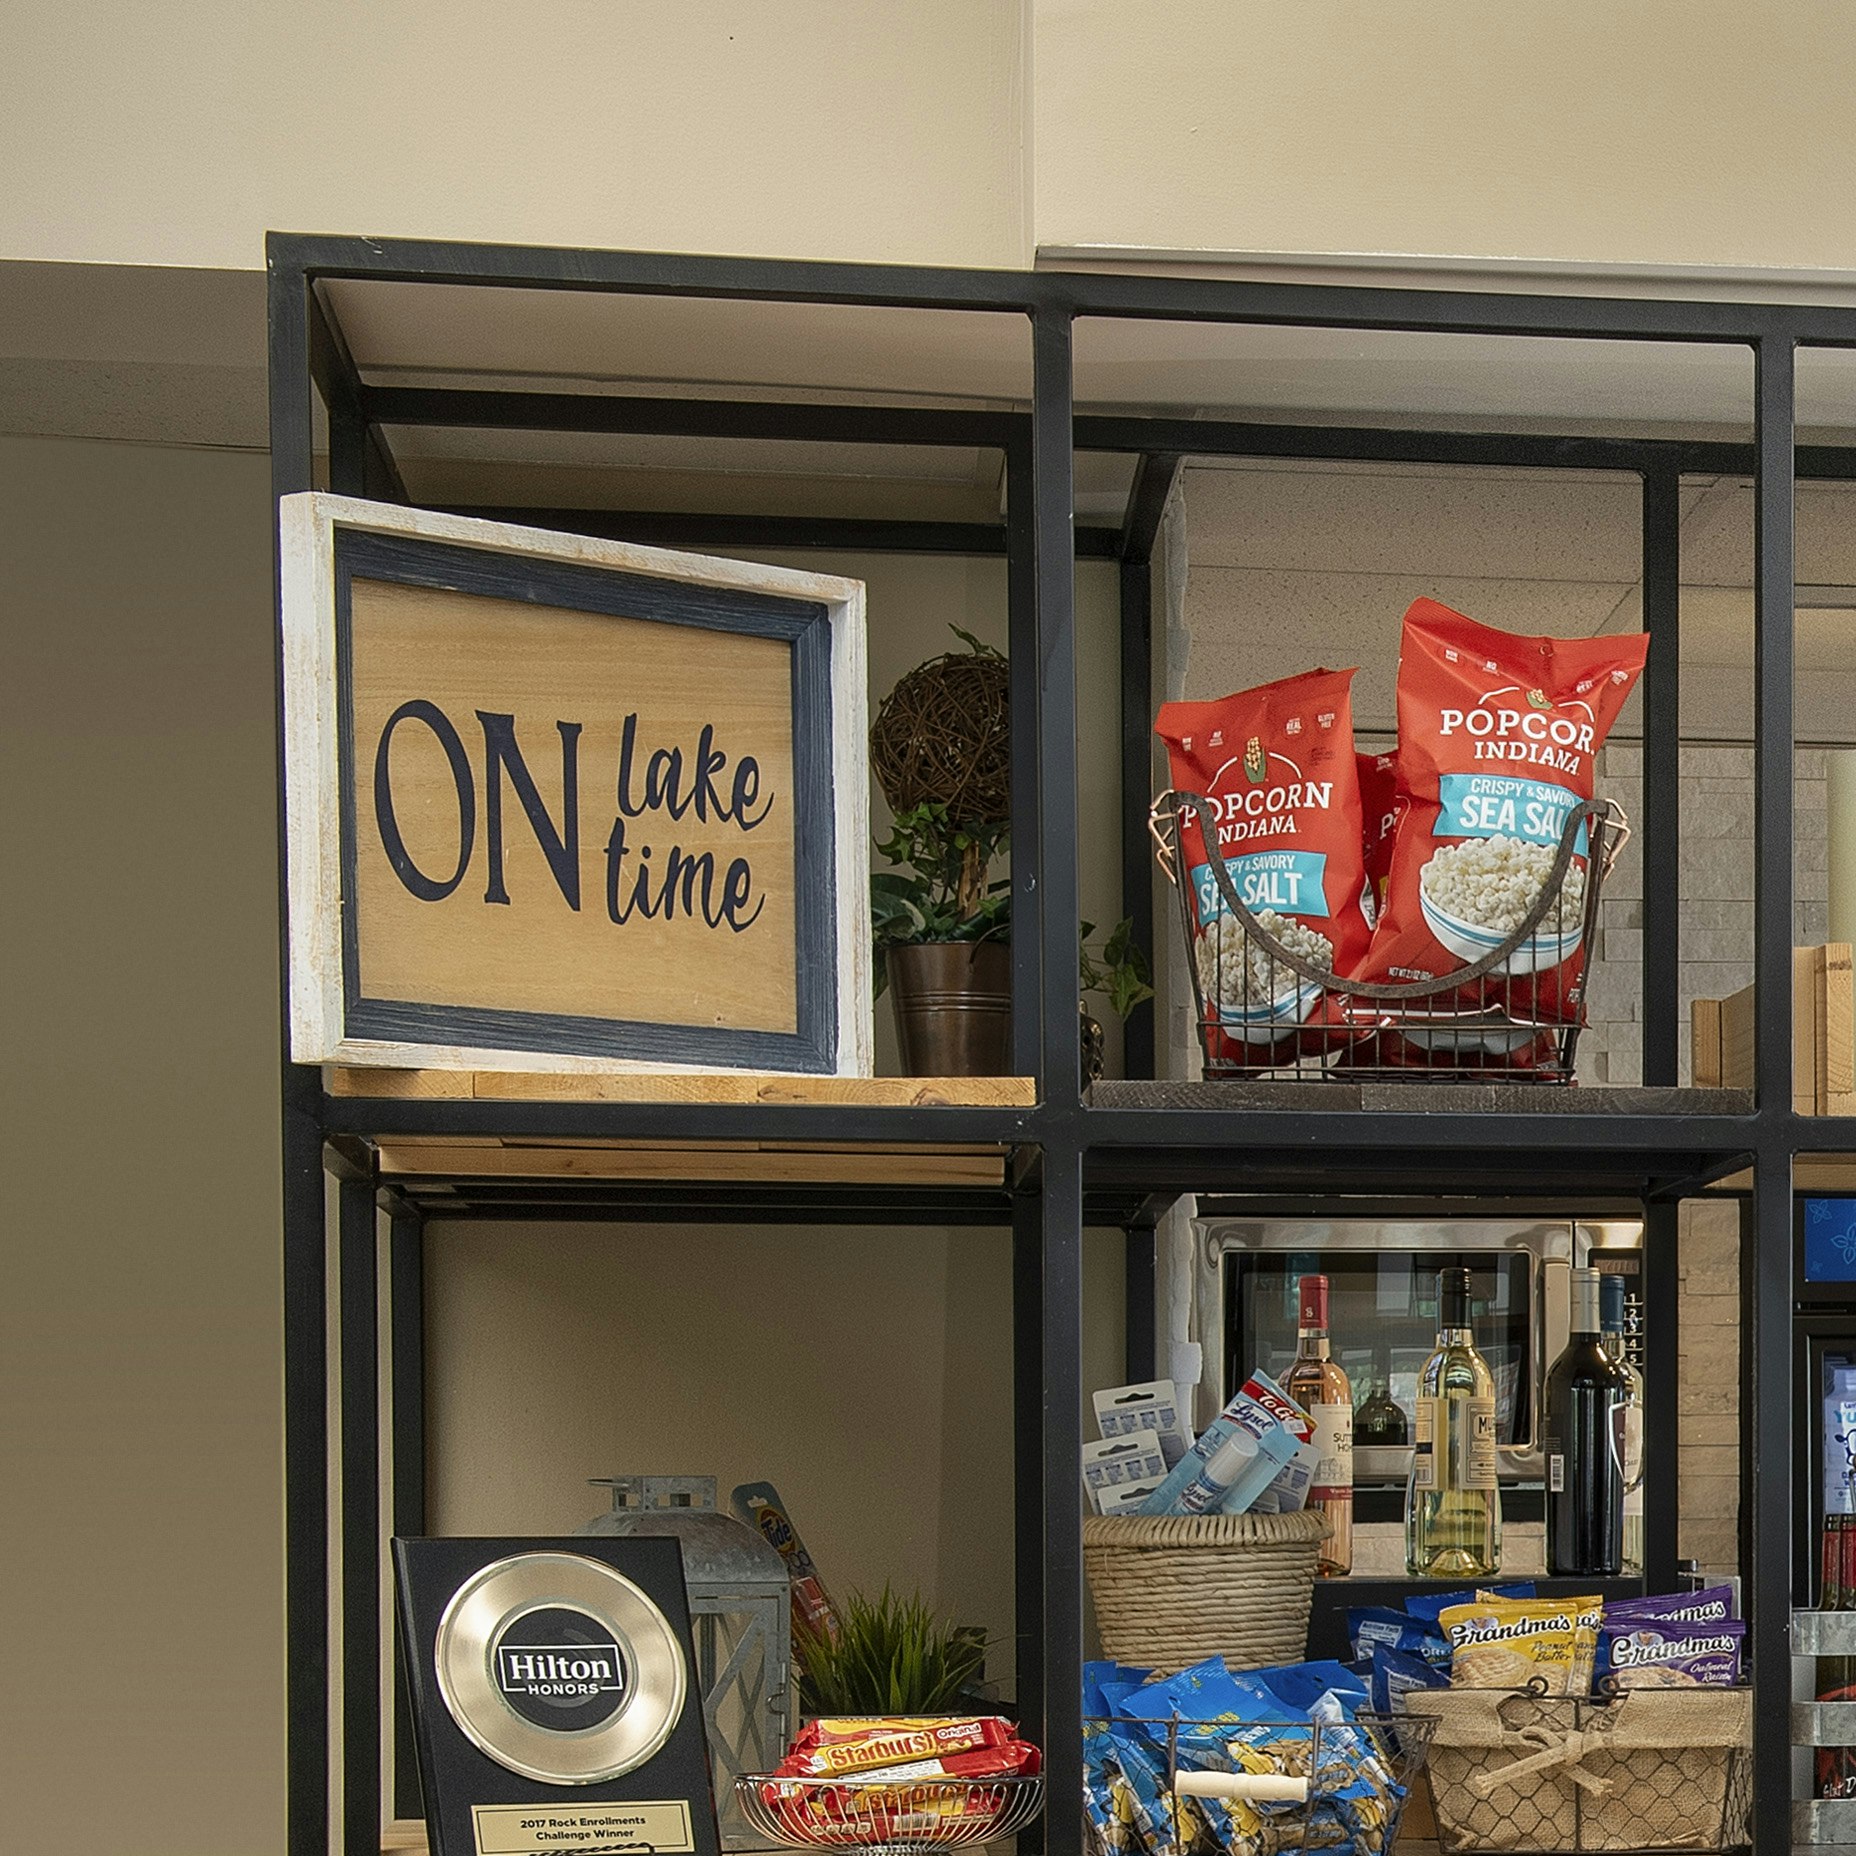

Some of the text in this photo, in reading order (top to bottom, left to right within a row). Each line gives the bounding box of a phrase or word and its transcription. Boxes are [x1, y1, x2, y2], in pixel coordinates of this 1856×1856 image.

[1440, 708, 1596, 755] POPCOR
[616, 713, 774, 831] lake
[1474, 740, 1581, 776] INDIANA
[1470, 777, 1524, 796] CRISPY
[373, 699, 583, 912] ON
[1459, 794, 1565, 839] SEA SAL
[604, 817, 766, 932] time
[1252, 854, 1296, 871] SAVORY
[1242, 872, 1303, 906] SALT
[1230, 1399, 1277, 1432] Lysol
[1258, 1390, 1276, 1410] To
[761, 1518, 792, 1545] Tide
[1449, 1612, 1574, 1649] Grandma's
[508, 1654, 613, 1680] Hilton
[1610, 1634, 1737, 1668] Grandma's
[528, 1683, 600, 1696] HONORS
[827, 1731, 938, 1768] Starburst
[520, 1815, 646, 1829] 2017 Rock Enrollments
[535, 1829, 635, 1842] Challenge Winner
